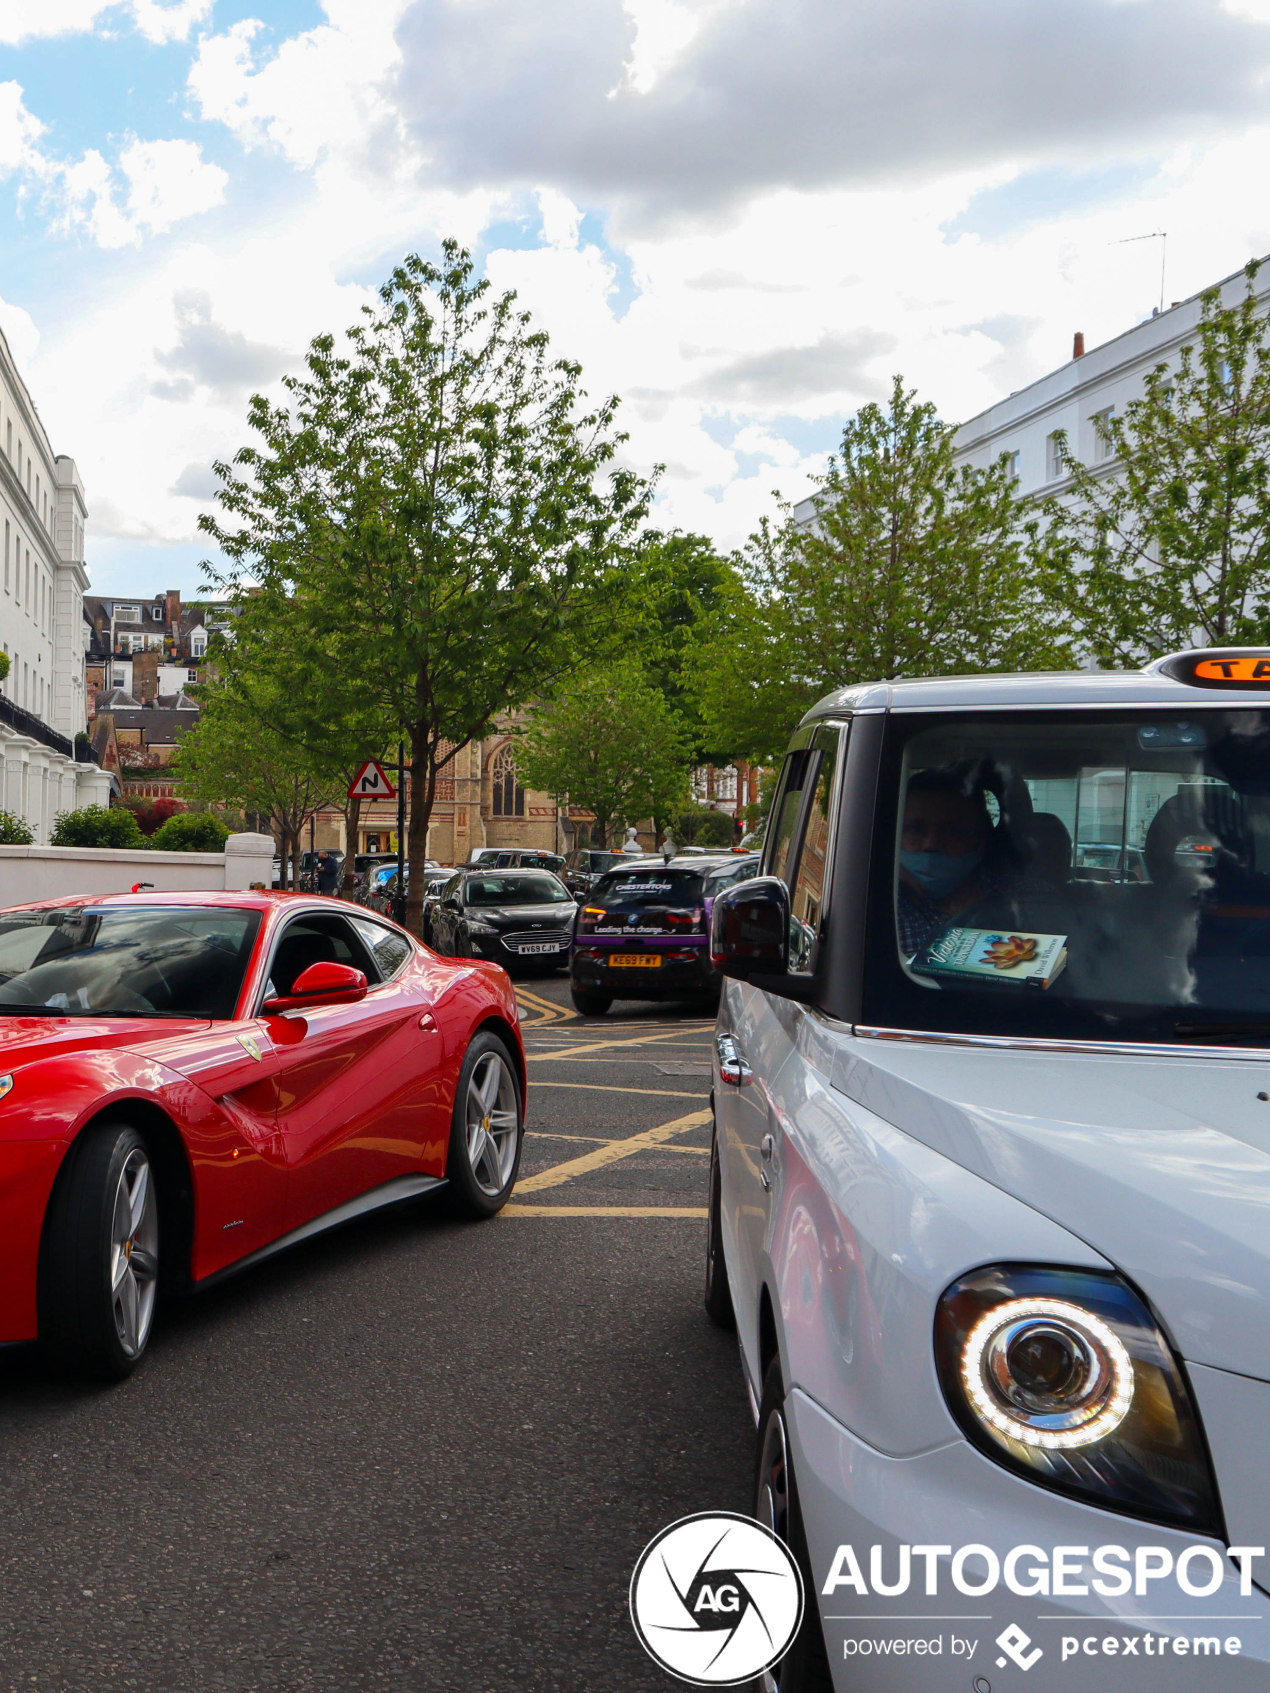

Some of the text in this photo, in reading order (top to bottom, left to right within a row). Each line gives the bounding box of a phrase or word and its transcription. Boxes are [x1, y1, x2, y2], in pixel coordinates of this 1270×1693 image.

[594, 926, 622, 934] Leading
[636, 926, 662, 934] charge
[928, 928, 964, 964] Victoria
[612, 956, 658, 964] KE69 FWY
[1034, 956, 1048, 974] David
